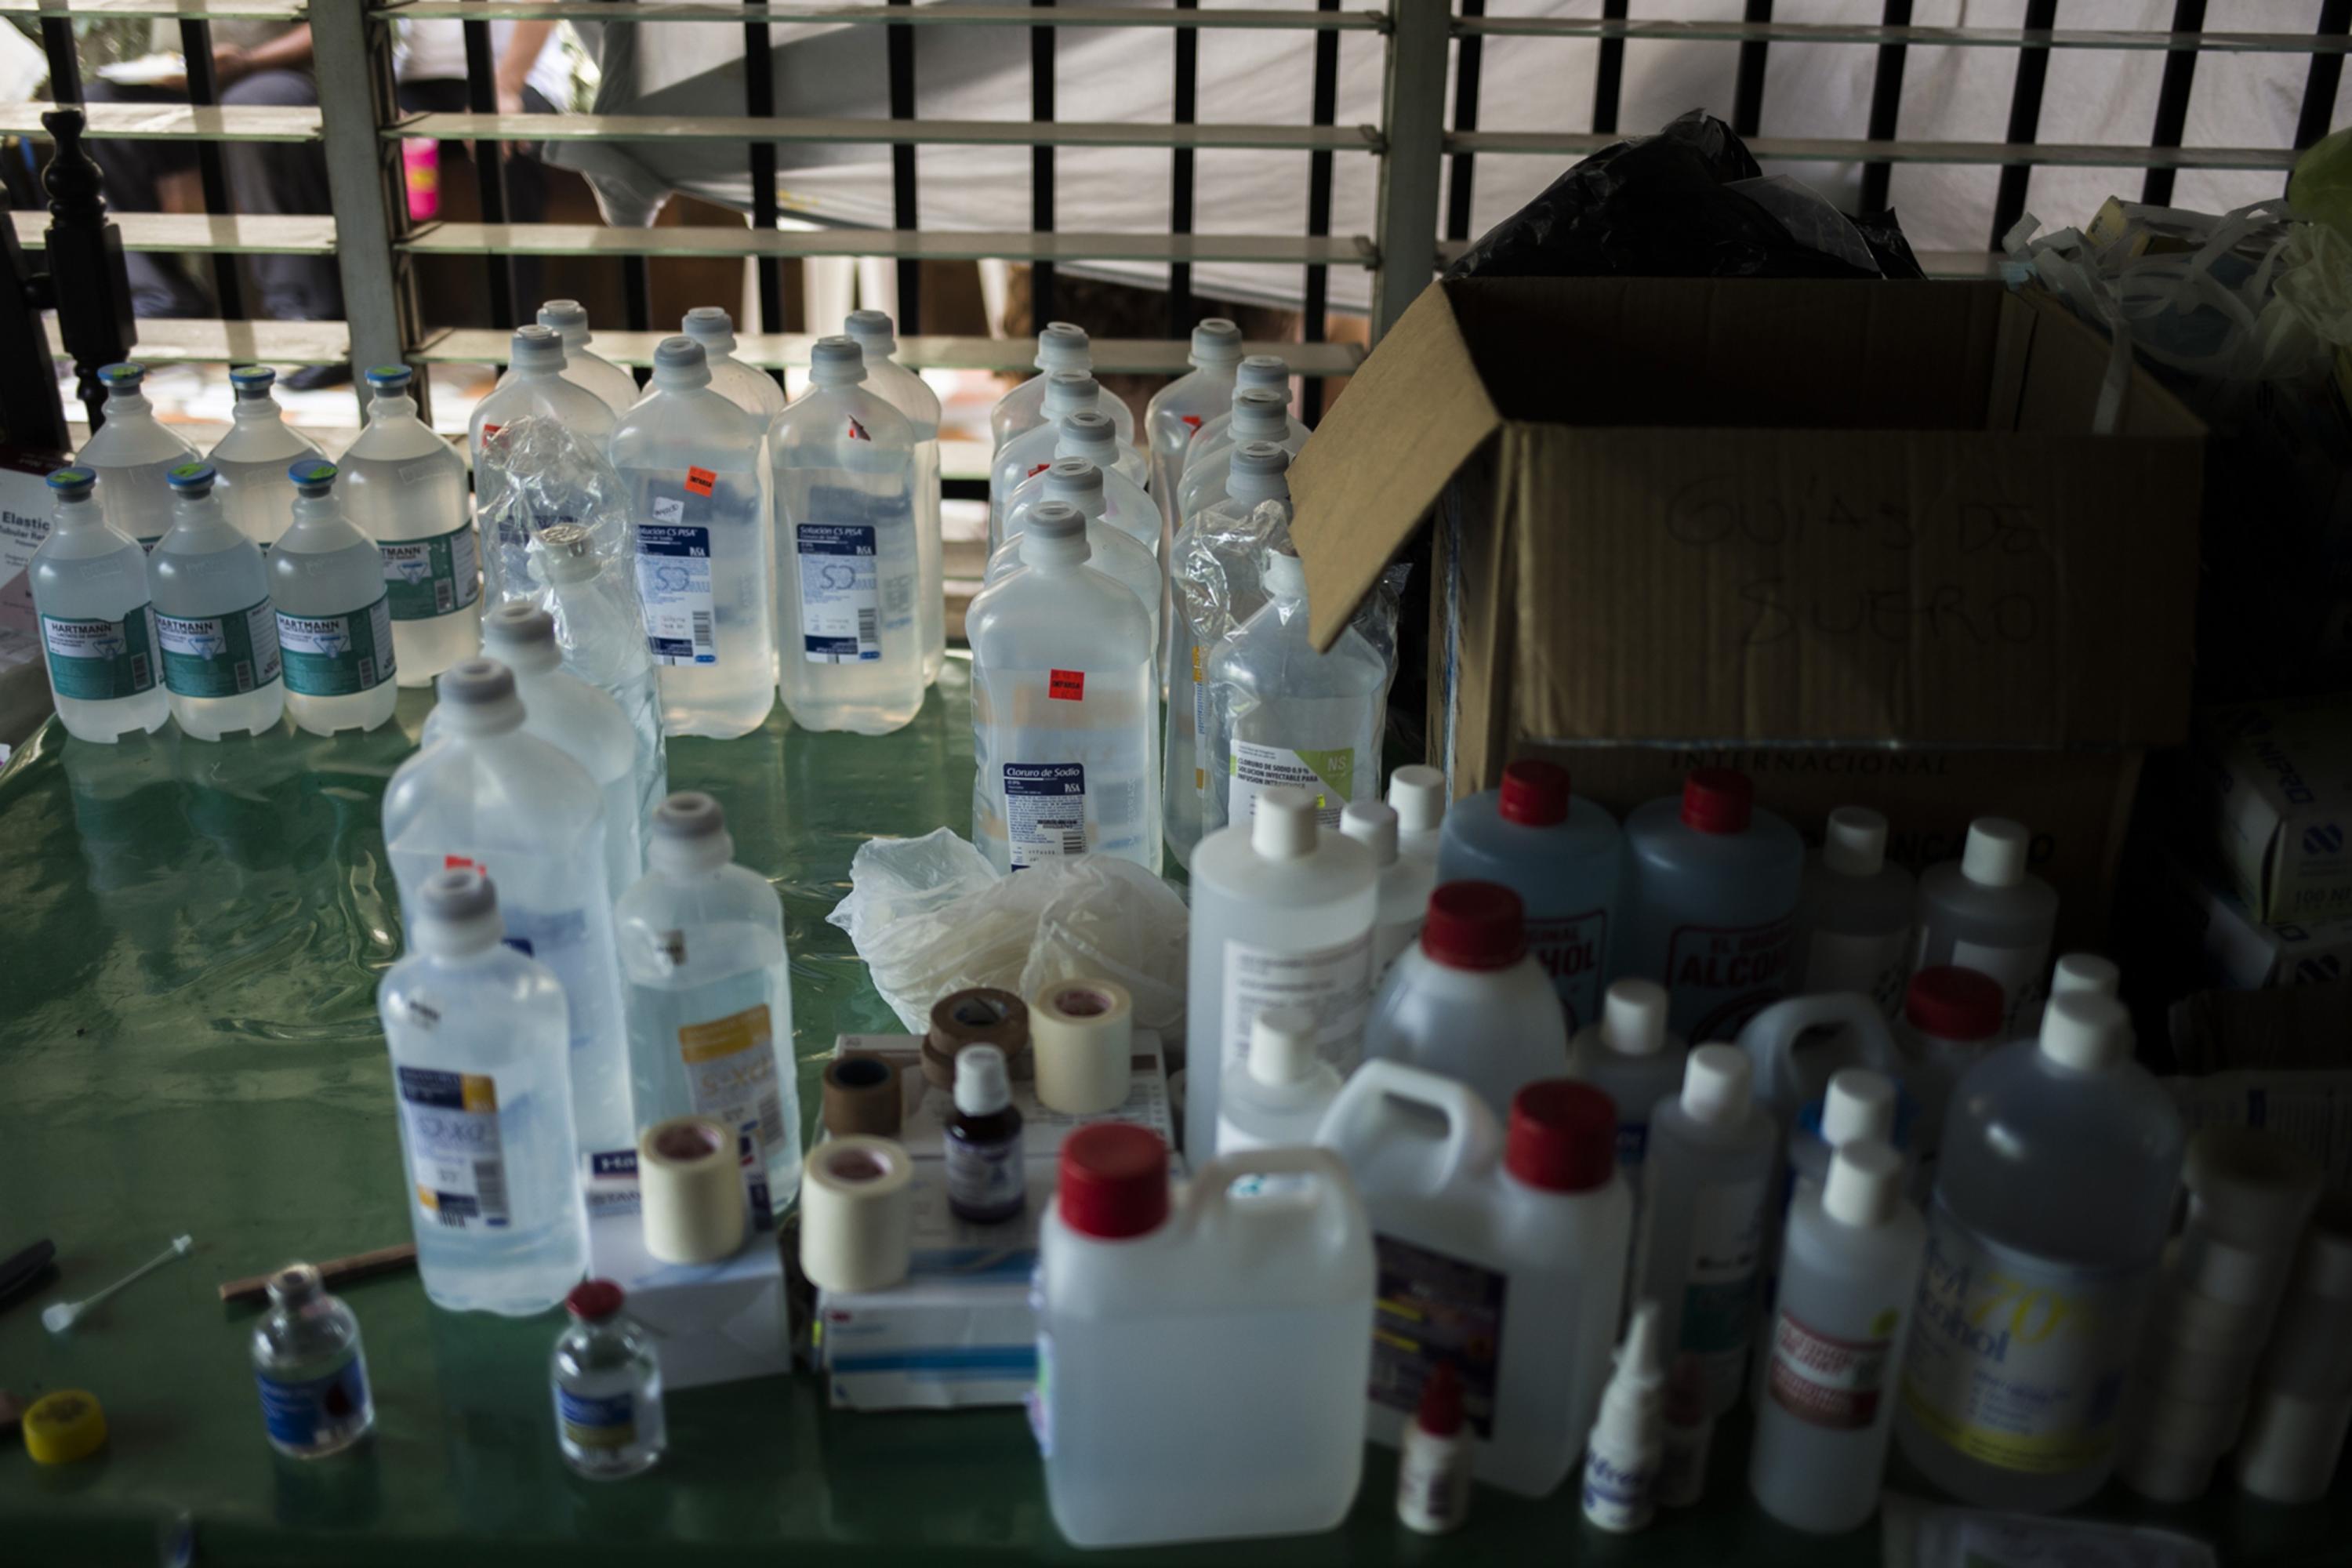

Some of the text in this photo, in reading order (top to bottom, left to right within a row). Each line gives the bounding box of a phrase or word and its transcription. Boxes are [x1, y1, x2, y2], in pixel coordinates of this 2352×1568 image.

[2, 511, 50, 531] Elastic
[1958, 499, 2042, 555] DE
[640, 526, 666, 536] olución
[381, 546, 421, 556] TMANN
[1738, 577, 2040, 645] SUERO
[52, 622, 111, 634] HARTMANN
[157, 618, 213, 630] HARTMANN
[279, 616, 339, 629] HARTMANN
[1238, 757, 1264, 768] CLORURO
[1327, 755, 1347, 771] NS
[1669, 750, 1951, 777] INTERNACIONAL
[1007, 767, 1080, 778] Cloruro de Sodio
